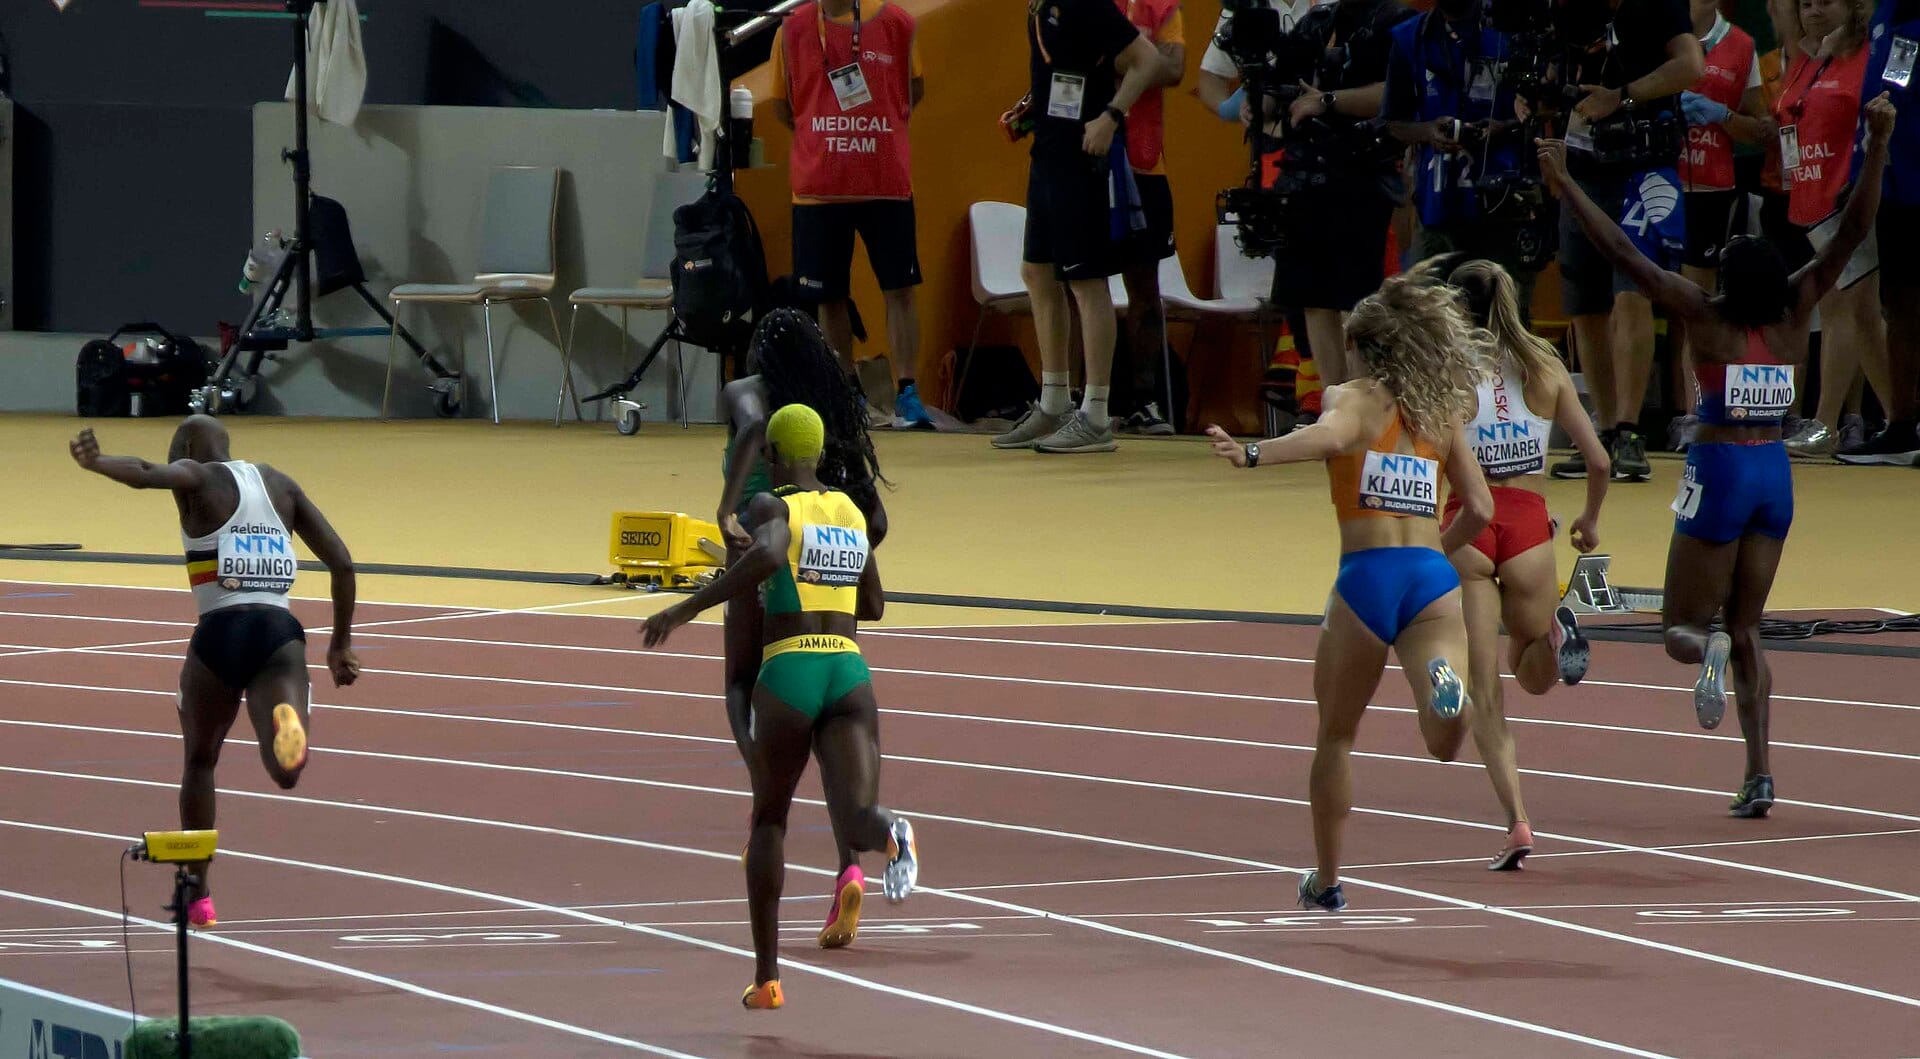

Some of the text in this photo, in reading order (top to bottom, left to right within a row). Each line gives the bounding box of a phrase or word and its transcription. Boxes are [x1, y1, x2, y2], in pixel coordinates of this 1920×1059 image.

[812, 117, 893, 132] MEDICAL
[825, 137, 876, 152] TEAM
[1742, 367, 1788, 384] NTN
[1730, 387, 1792, 405] PAULINO
[1478, 420, 1530, 442] NTN
[1472, 438, 1541, 462] ACZMAREK
[1381, 456, 1427, 477] NTN
[1367, 475, 1432, 500] KLAVER
[1682, 486, 1694, 509] 7
[235, 535, 284, 554] NTN
[621, 531, 661, 546] SEIKO
[816, 526, 857, 546] NTN
[224, 558, 293, 576] BOLINGO
[806, 548, 864, 569] McLEOD
[798, 638, 845, 649] JAMAICA
